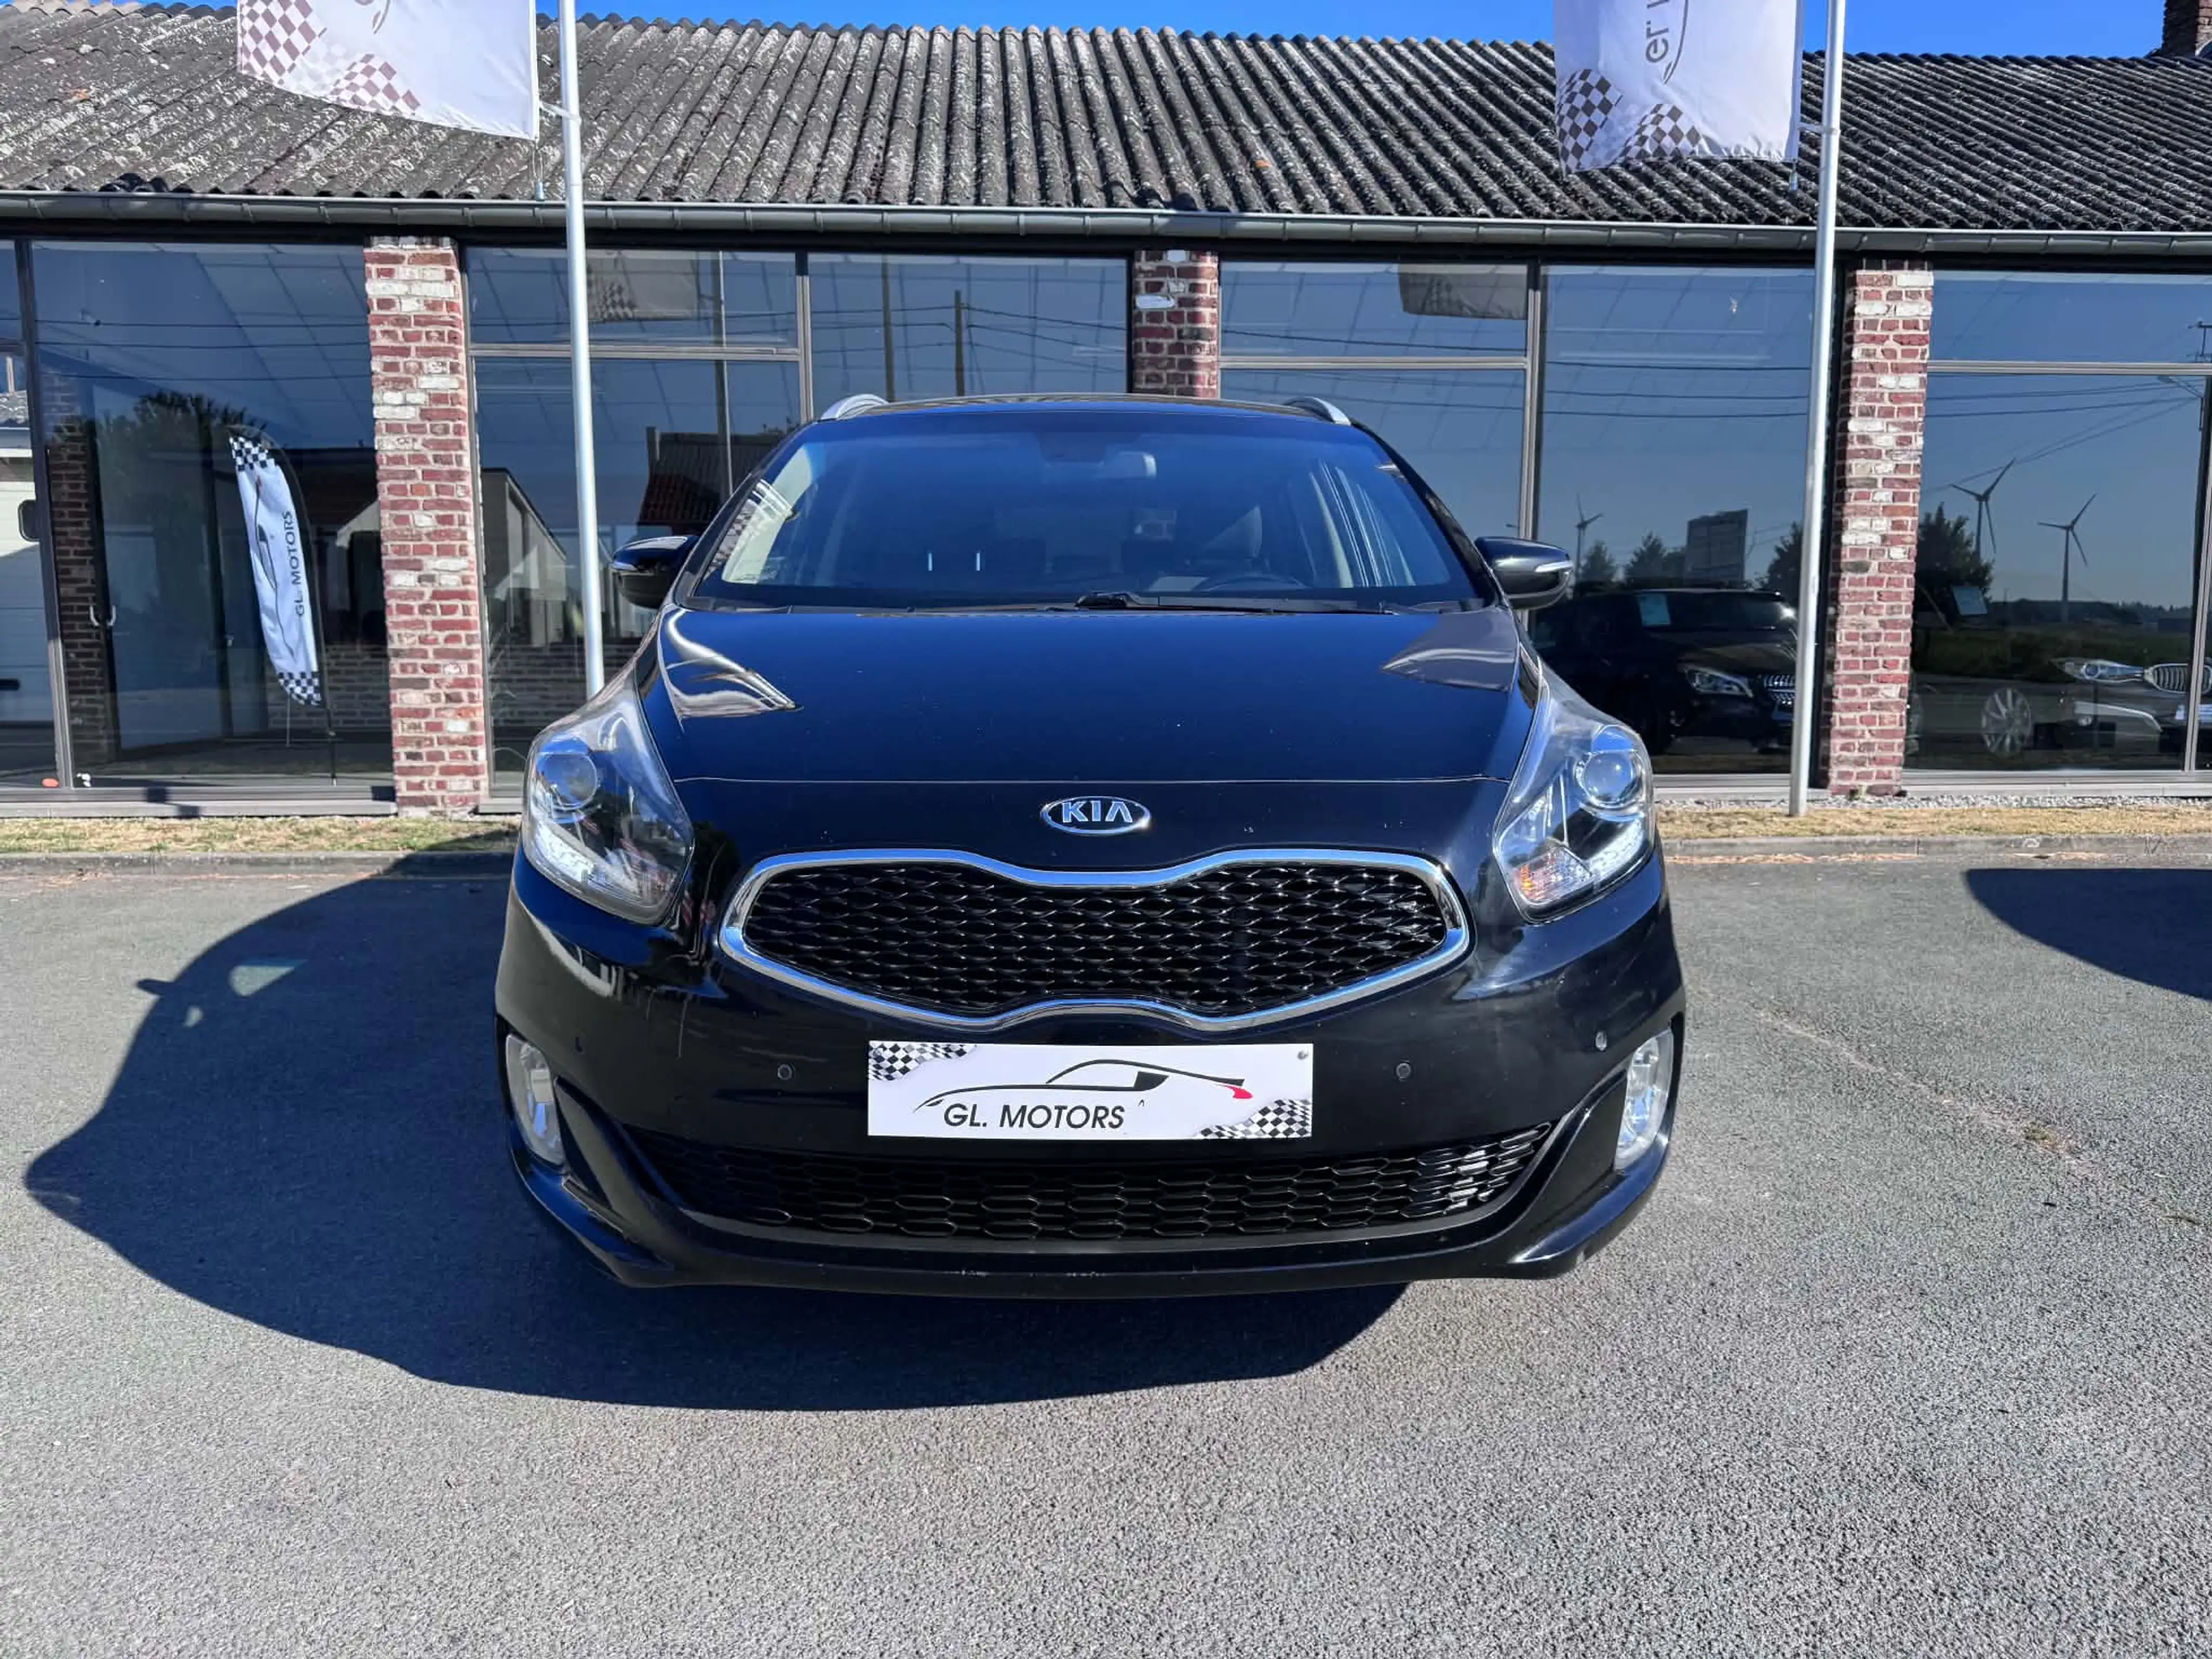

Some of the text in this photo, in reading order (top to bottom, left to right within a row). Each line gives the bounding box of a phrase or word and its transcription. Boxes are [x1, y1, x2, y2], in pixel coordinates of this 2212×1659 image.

[282, 510, 302, 585] MOTORS
[1062, 800, 1133, 823] KIA
[944, 1103, 1126, 1129] GL. MOTORS
